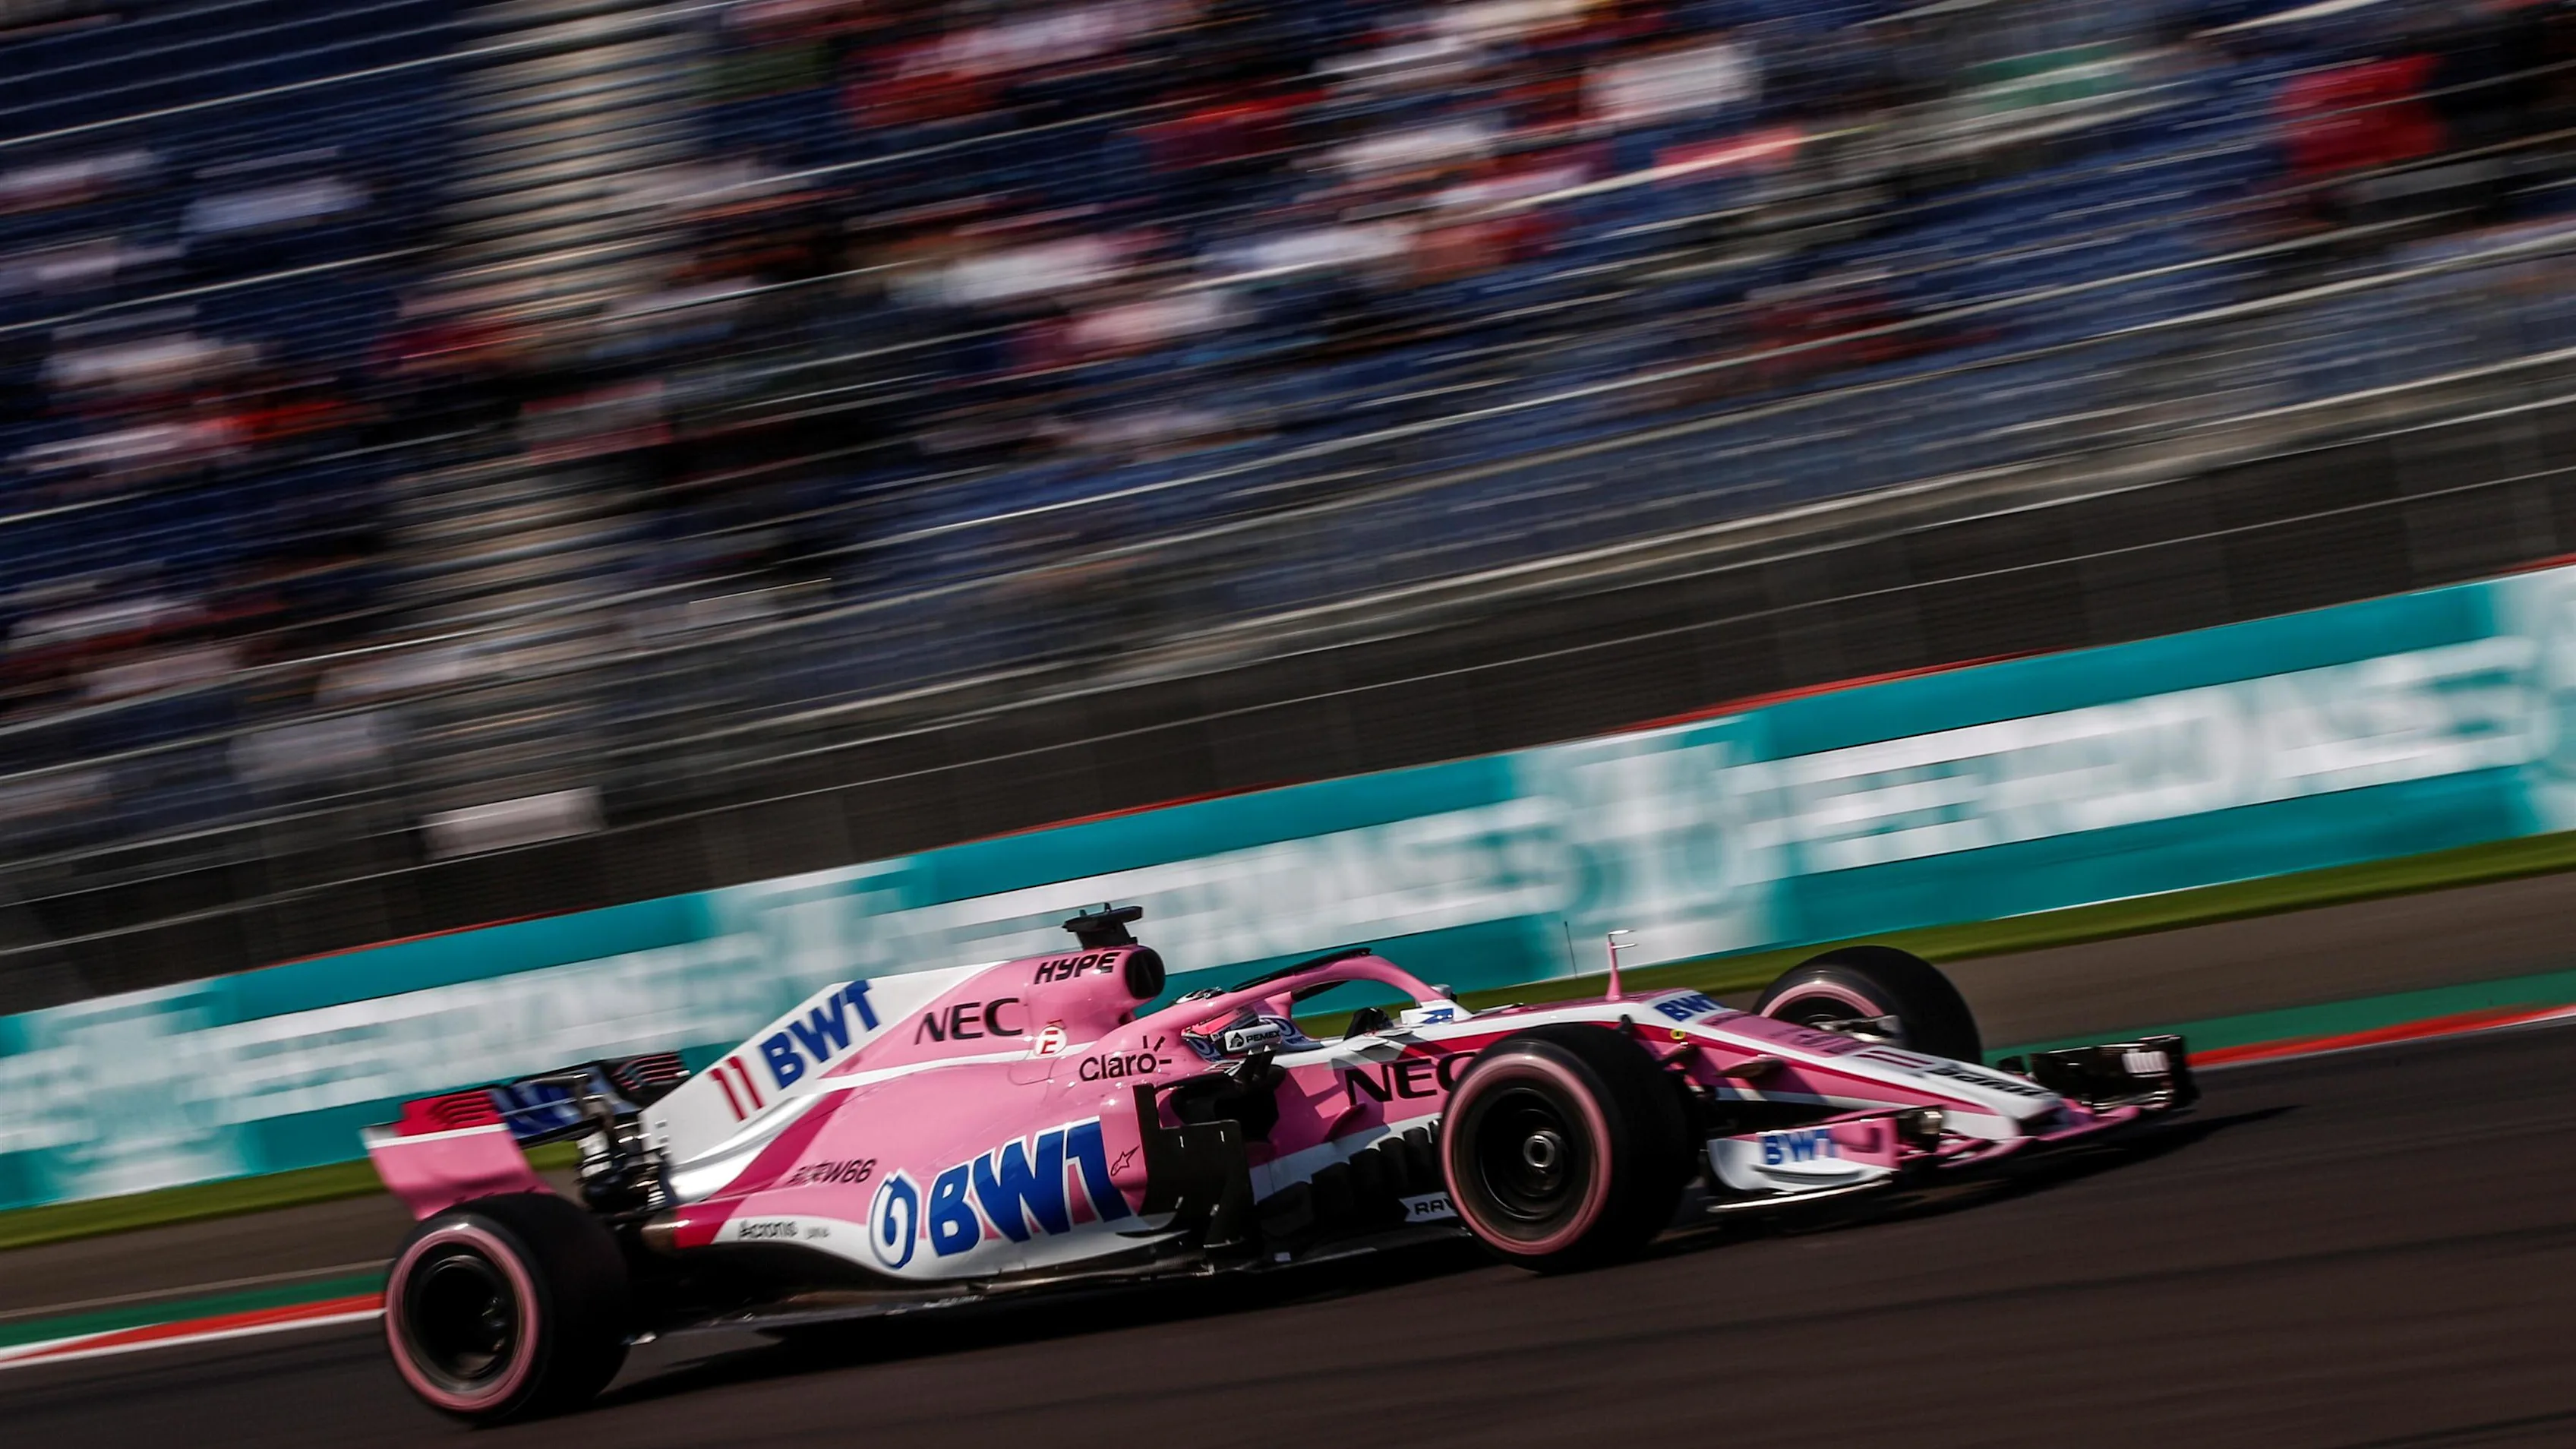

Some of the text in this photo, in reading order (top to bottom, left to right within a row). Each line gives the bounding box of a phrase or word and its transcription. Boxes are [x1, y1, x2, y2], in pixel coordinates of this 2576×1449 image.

[1034, 952, 1122, 985] HYPE
[756, 978, 882, 1091] BWT
[914, 997, 1024, 1046] NEC
[1245, 1029, 1283, 1044] PEMEX
[706, 1055, 766, 1122] 11
[1079, 1053, 1157, 1082] Claro
[1344, 1051, 1476, 1106] NEC
[1761, 1129, 1836, 1166] BWT
[927, 1119, 1132, 1258] BWT
